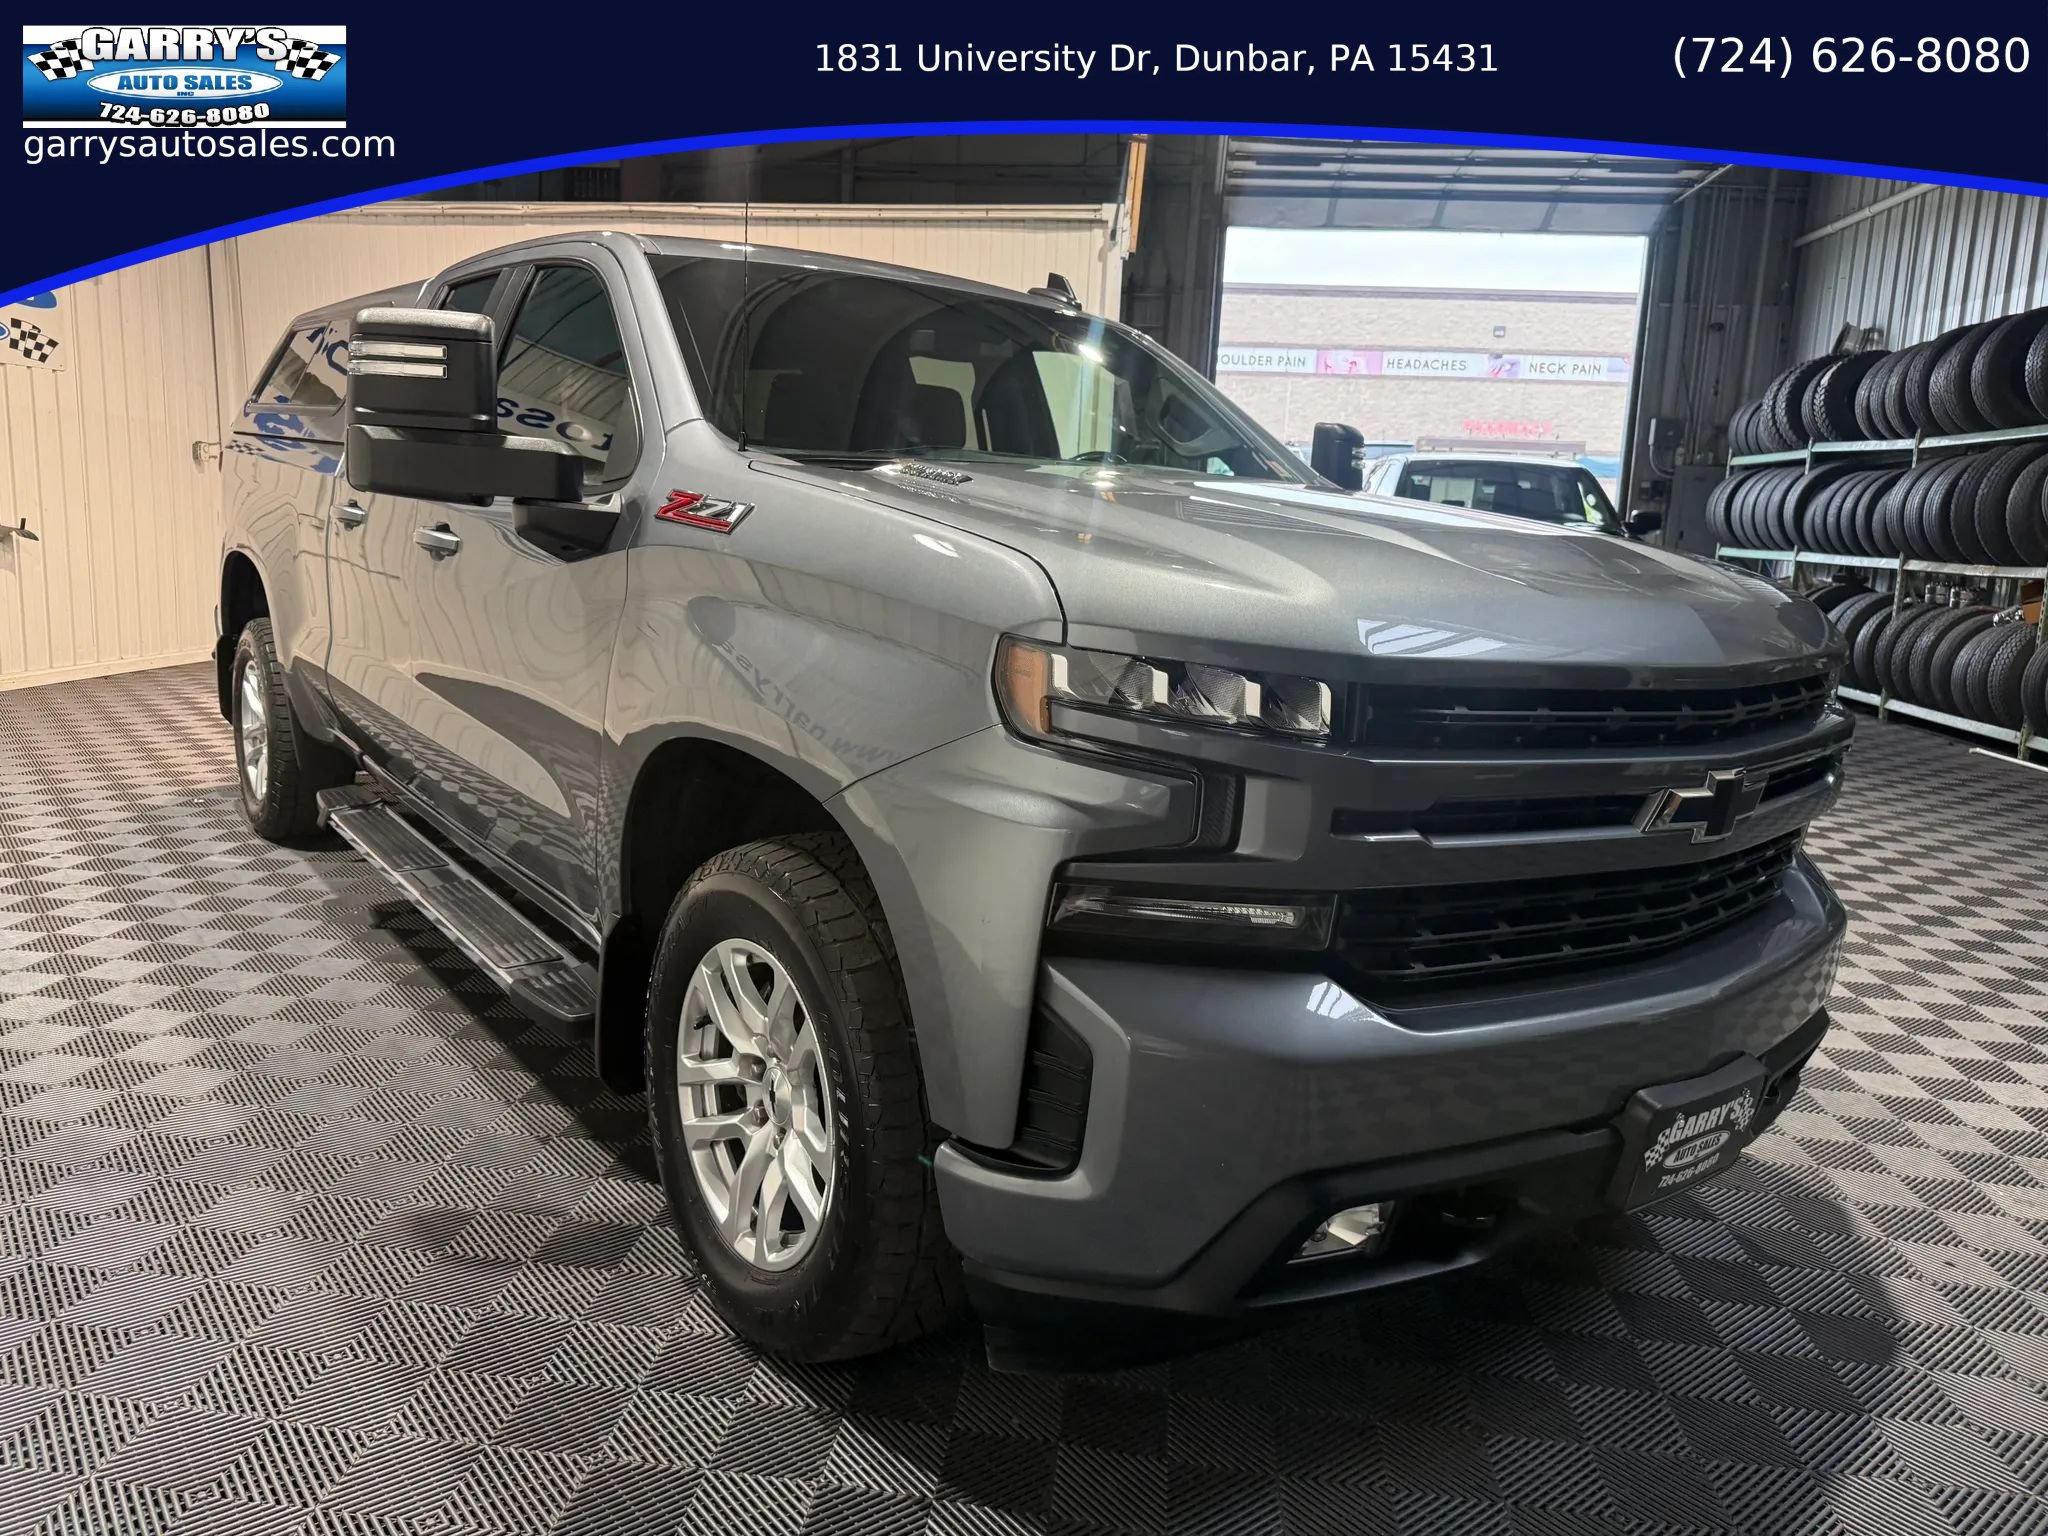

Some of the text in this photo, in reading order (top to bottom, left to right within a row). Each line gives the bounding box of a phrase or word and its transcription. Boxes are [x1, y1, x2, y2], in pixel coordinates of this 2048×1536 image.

[1219, 353, 1306, 369] OULDER PAIN
[1386, 358, 1468, 372] HEADACHES
[1529, 361, 1602, 376] NECK PAIN
[655, 488, 756, 535] Z71
[1669, 1097, 1744, 1144] GARRY'S
[1673, 1133, 1722, 1163] AUTO SALES
